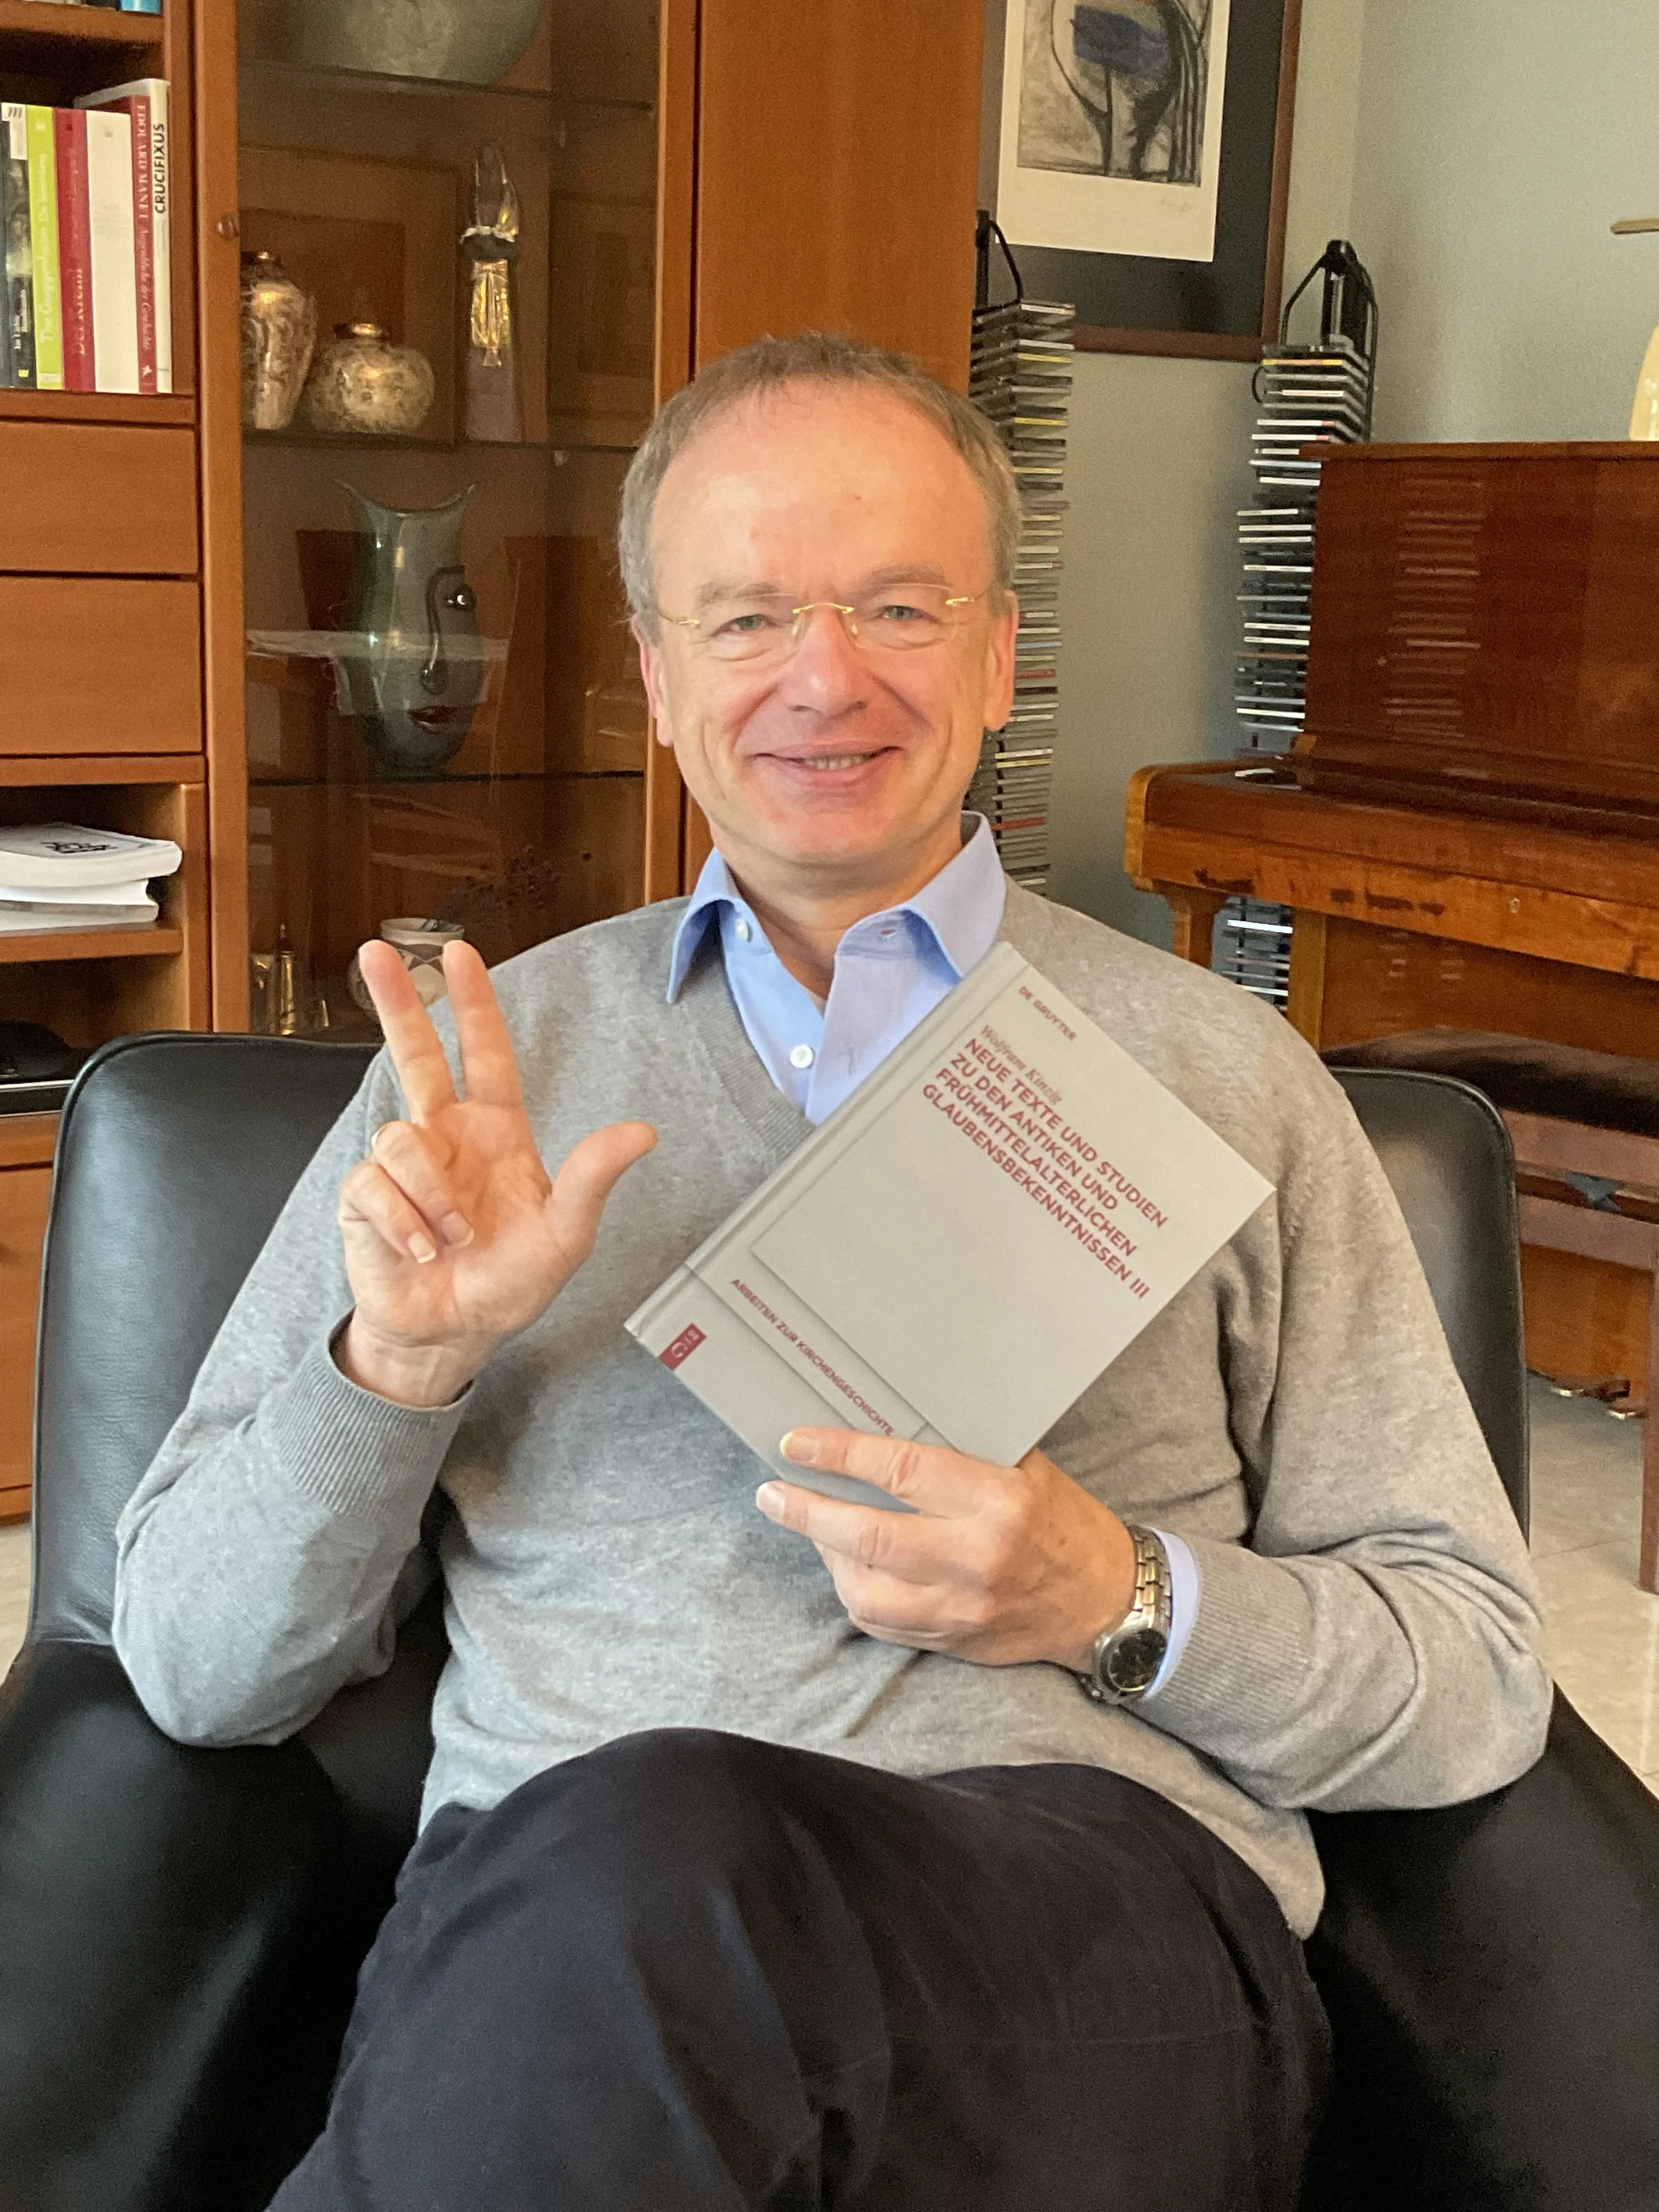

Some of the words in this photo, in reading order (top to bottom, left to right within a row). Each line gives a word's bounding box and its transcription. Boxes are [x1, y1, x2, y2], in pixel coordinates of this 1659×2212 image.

[138, 172, 149, 221] MANET
[153, 123, 166, 213] CRUCIFIXUS
[981, 1025, 1026, 1069] Wolfram
[1025, 1069, 1062, 1105] Kinzig
[1019, 986, 1034, 1001] DE
[1034, 1000, 1076, 1041] GRUYTER
[923, 1084, 1132, 1282] GLAUBENSBEKENNTNISSEN
[1129, 1278, 1150, 1299] III
[935, 1068, 1137, 1257] FRÜHMITTELALTERLICHEN
[950, 1053, 978, 1077] ZU
[974, 1075, 1013, 1111] DEN
[1008, 1110, 1082, 1177] ANTIKEN
[1081, 1173, 1118, 1210] UND
[965, 1038, 1012, 1082] NEUE
[1011, 1078, 1063, 1130] TEXTE
[1060, 1126, 1098, 1162] UND
[1097, 1161, 1169, 1228] STUDIEN
[671, 1342, 689, 1358] G
[731, 1279, 778, 1324] ARBEITEN
[776, 1321, 799, 1342] ZUR
[797, 1340, 895, 1436] KIRCHENGESCHICHTE
